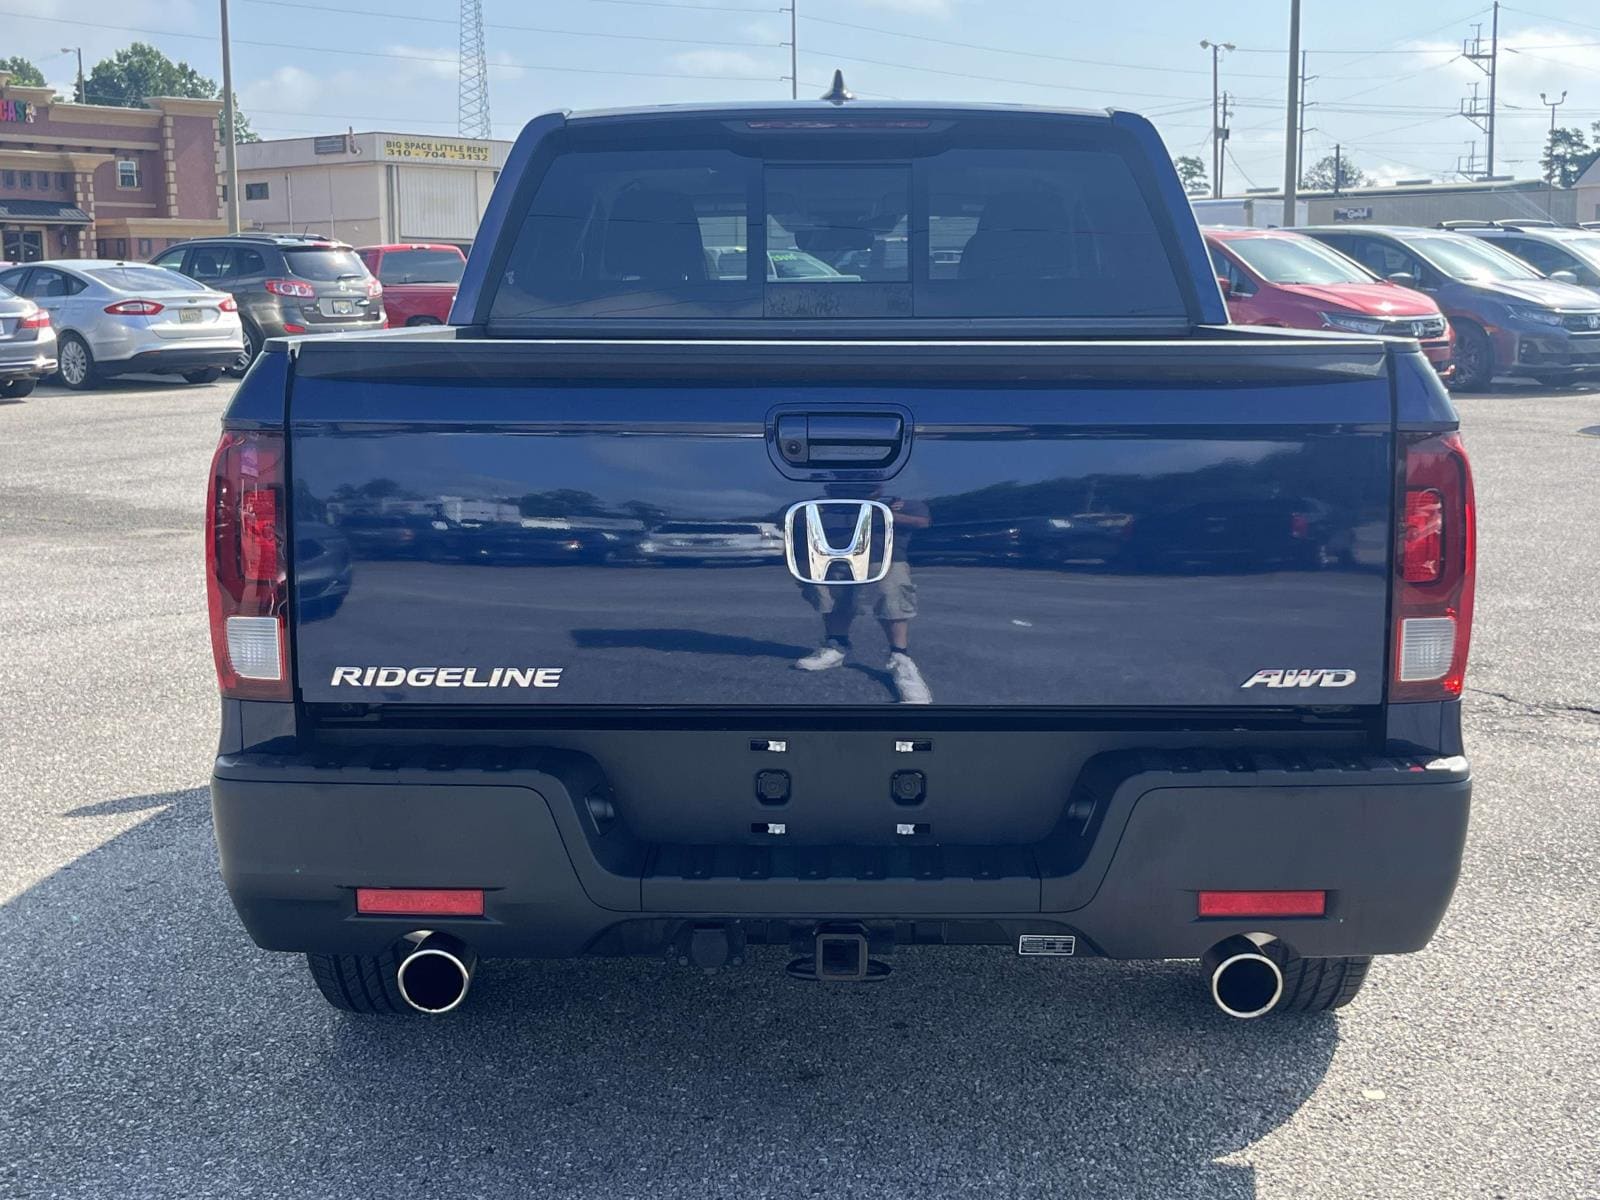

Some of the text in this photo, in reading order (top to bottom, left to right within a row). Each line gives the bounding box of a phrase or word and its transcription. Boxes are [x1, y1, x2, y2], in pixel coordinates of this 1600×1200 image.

[386, 140, 489, 154] BIG SPACE LITTLE RENT
[331, 666, 563, 688] RIDGELINE
[1240, 669, 1356, 688] AWD
